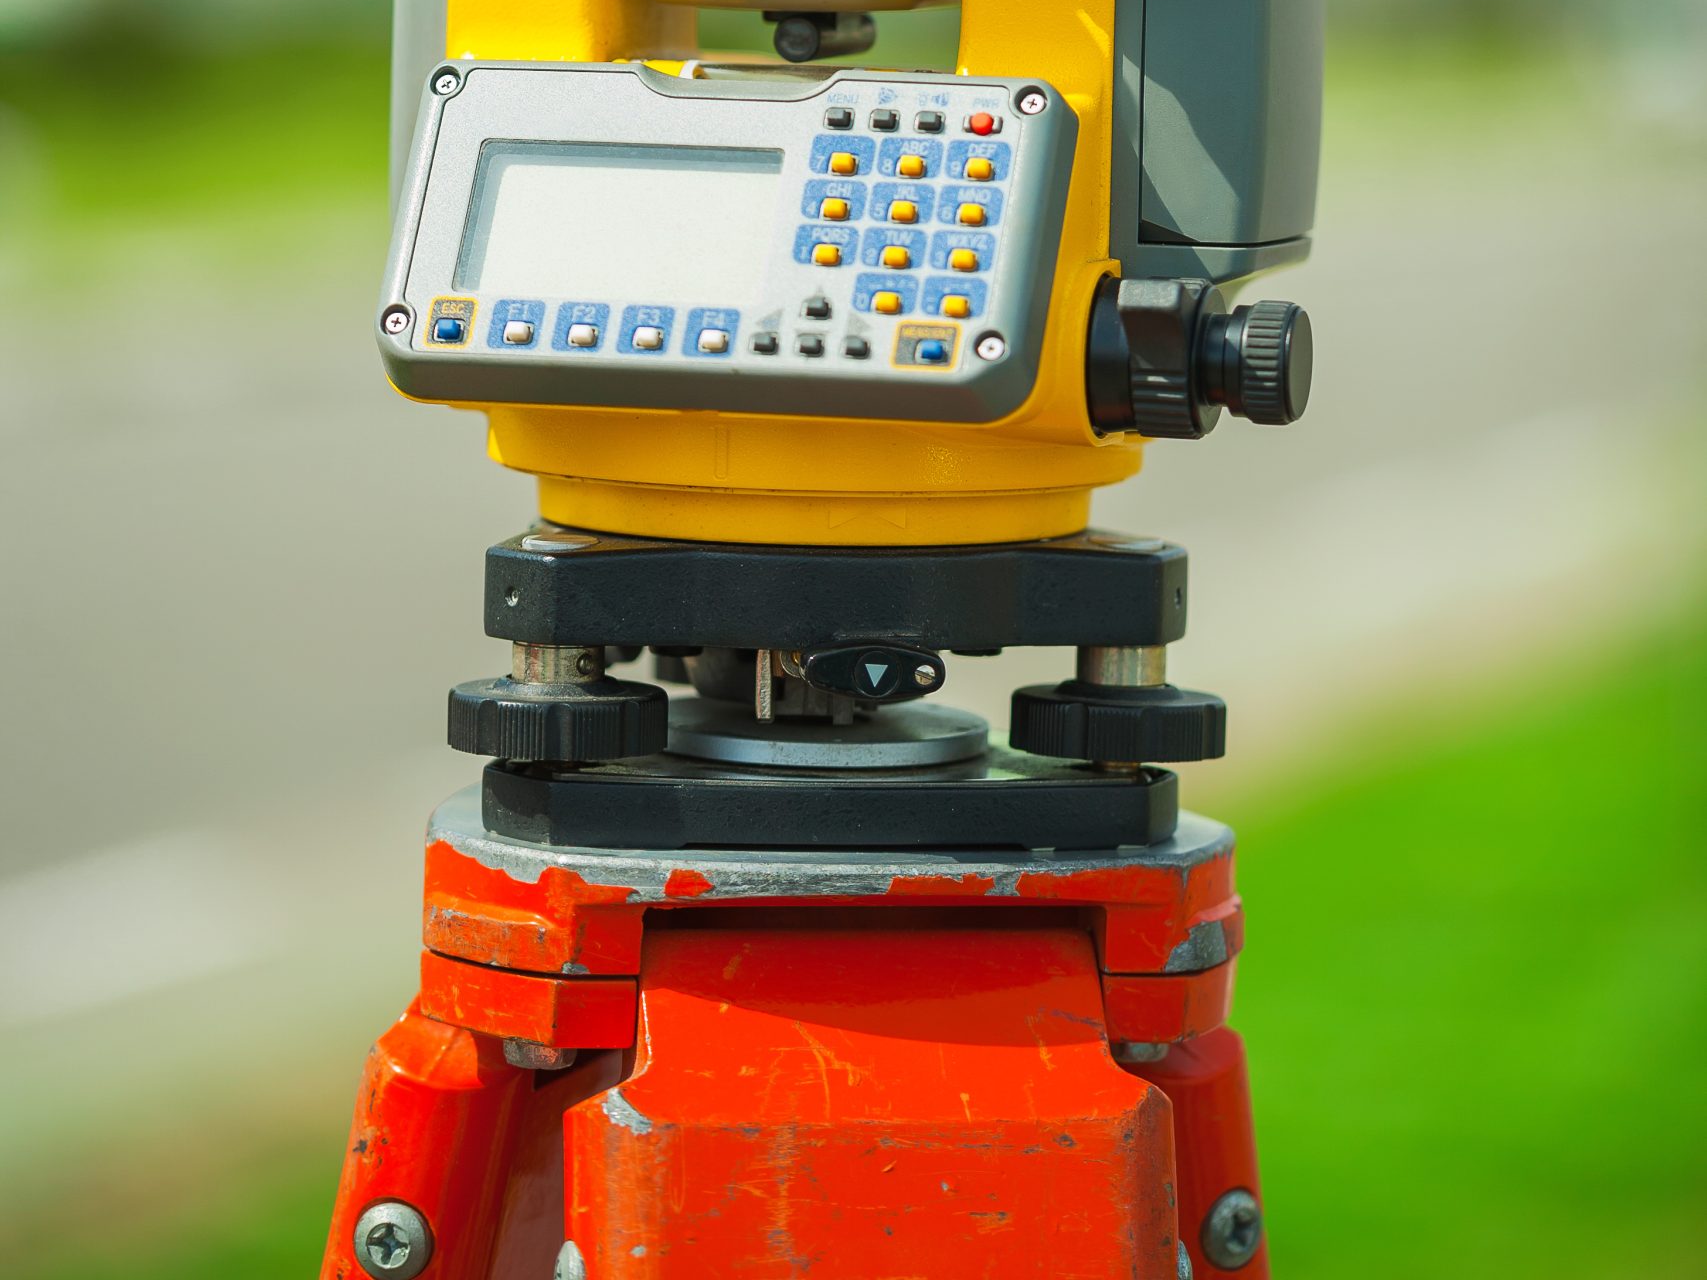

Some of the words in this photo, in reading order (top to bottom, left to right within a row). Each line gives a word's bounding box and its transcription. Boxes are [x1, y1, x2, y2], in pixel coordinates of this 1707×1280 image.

[826, 94, 859, 104] MENU
[973, 98, 999, 109] PWR
[901, 141, 930, 155] ABC
[966, 143, 997, 157] DEF
[816, 156, 825, 169] 7
[826, 182, 853, 197] GHI
[893, 186, 919, 200] JKL
[957, 187, 993, 203] MNO
[806, 201, 817, 215] 4
[873, 203, 885, 217] 5
[812, 228, 850, 243] PQRS
[885, 230, 914, 245] TUV
[946, 234, 989, 250] WXYZ
[441, 303, 465, 314] ESC
[507, 303, 530, 319] F1
[571, 305, 596, 321] F2
[637, 308, 661, 324] F3
[702, 311, 726, 326] F4
